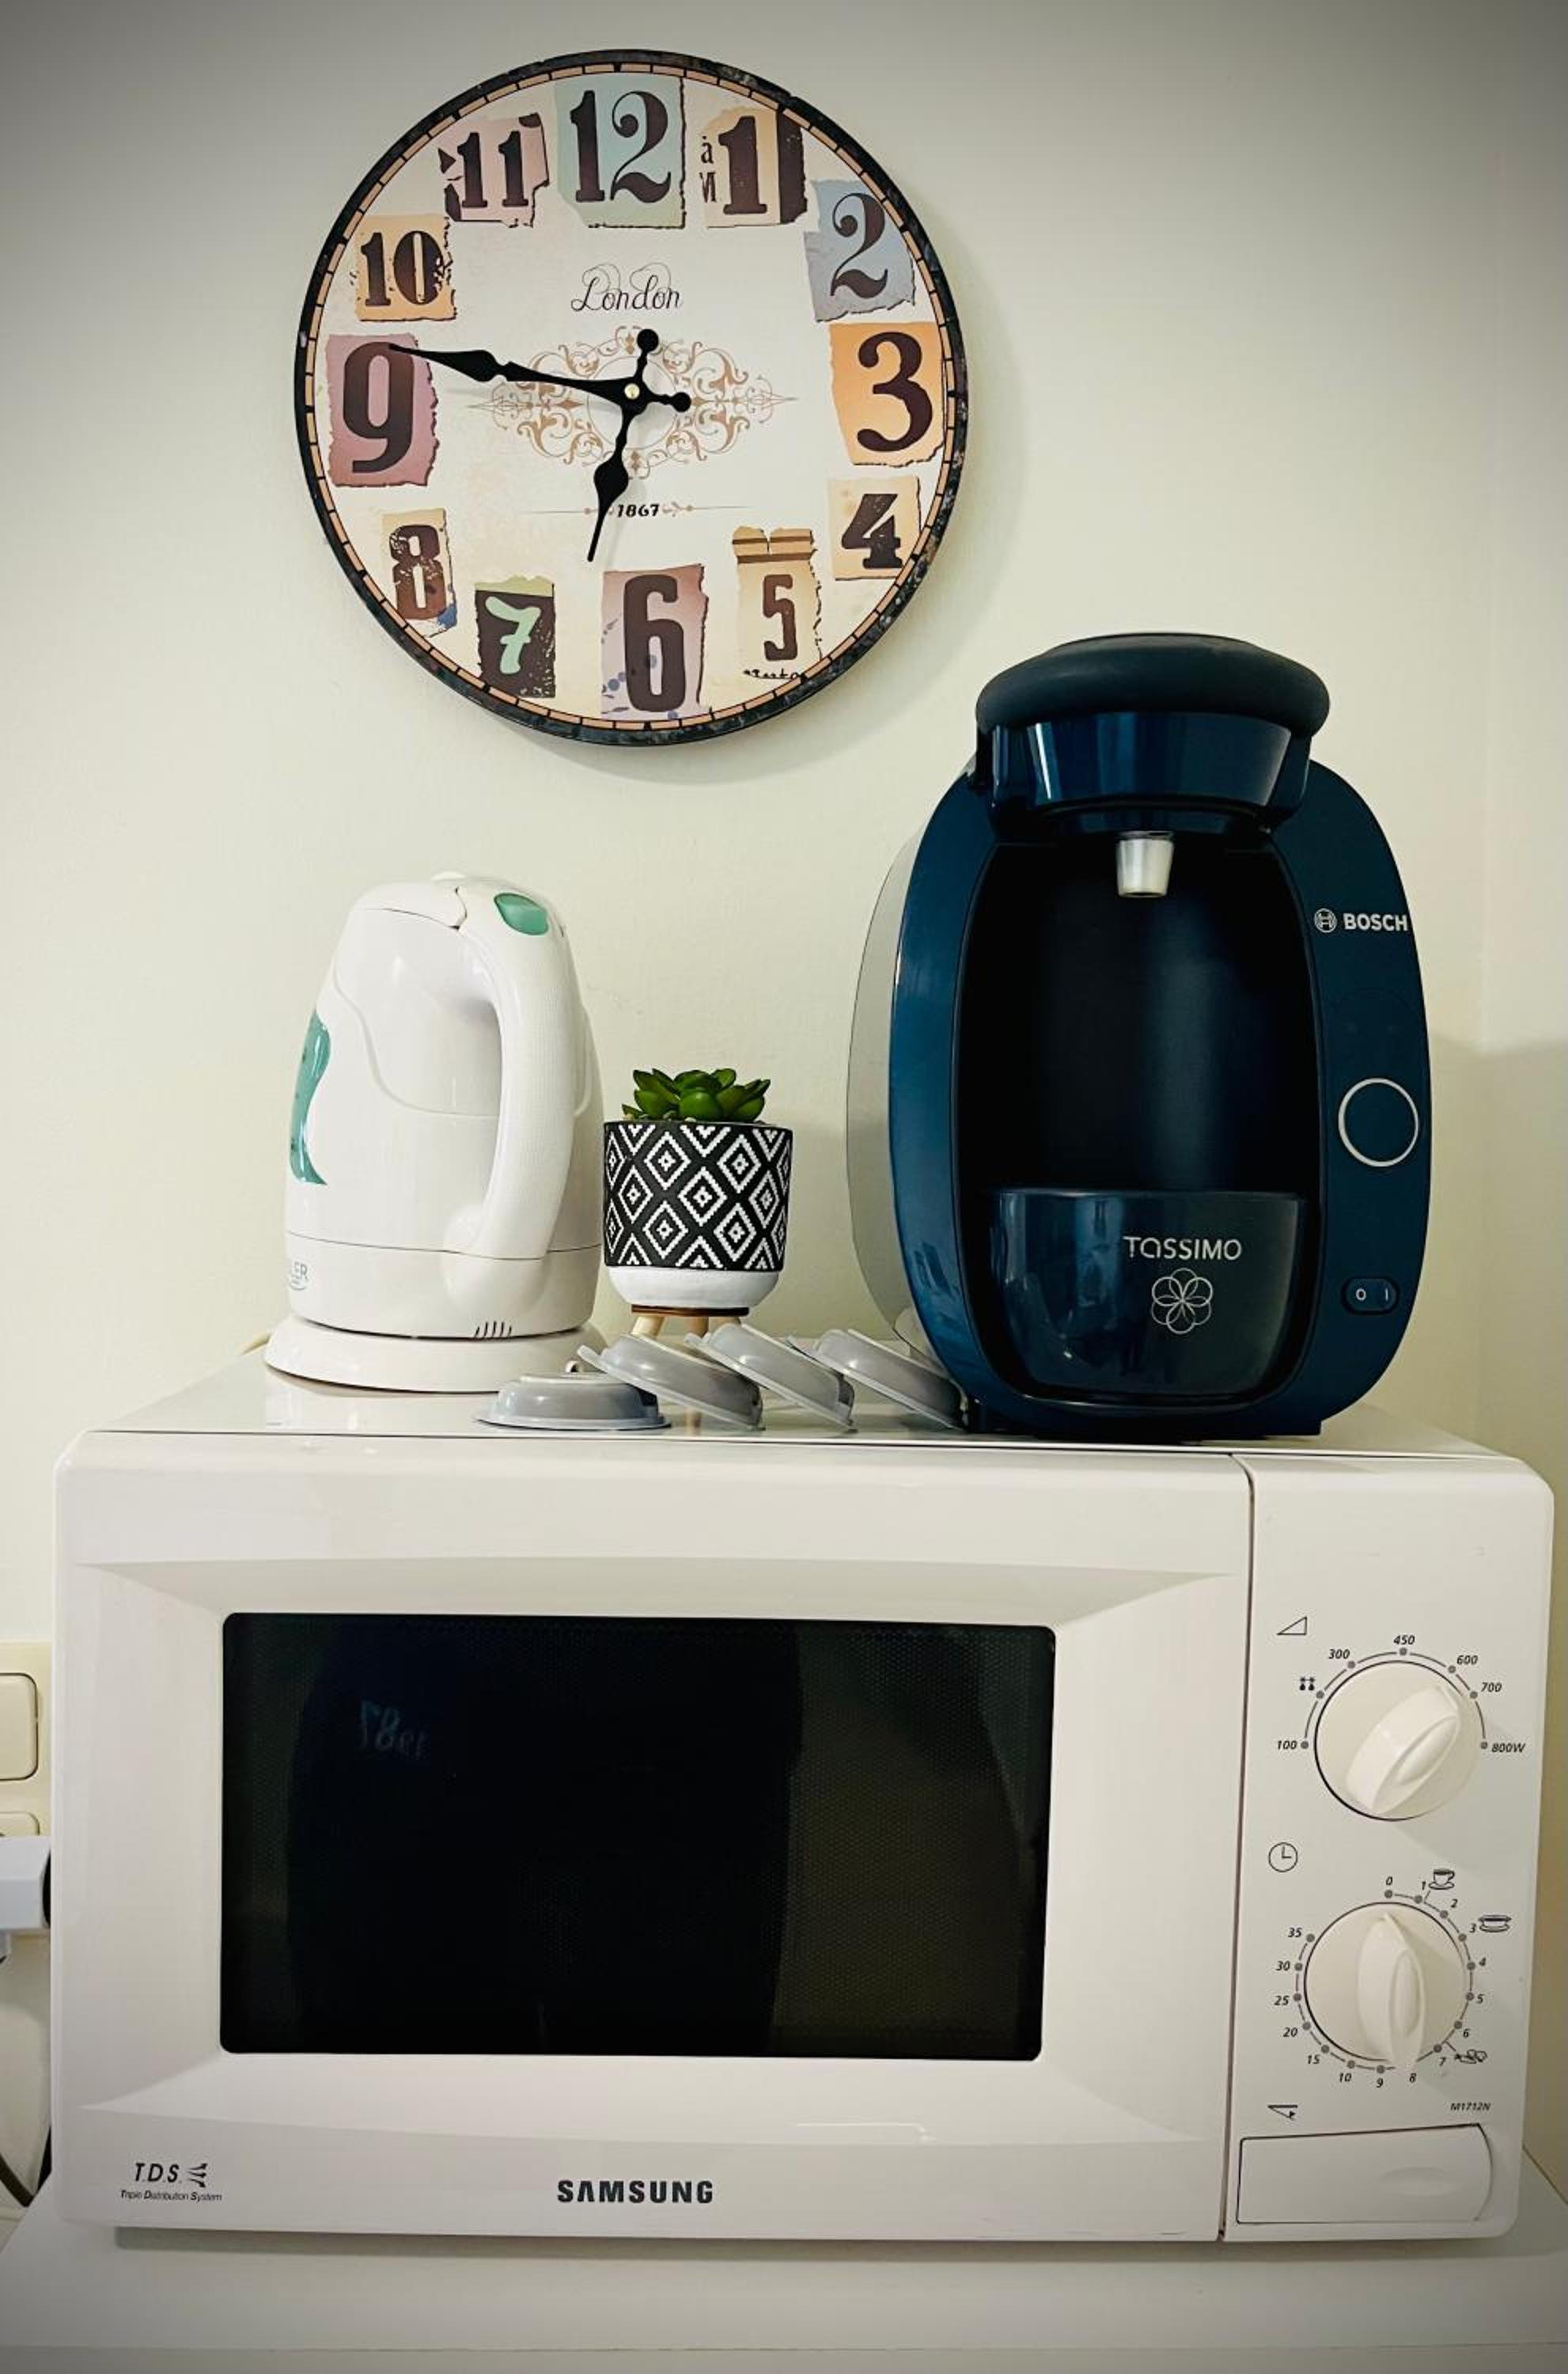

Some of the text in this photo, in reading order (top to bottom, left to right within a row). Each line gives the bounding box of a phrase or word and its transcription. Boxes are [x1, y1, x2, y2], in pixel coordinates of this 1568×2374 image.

[570, 89, 672, 203] 12
[456, 131, 530, 209] 11
[718, 116, 767, 214] 1
[830, 192, 888, 299] 2
[360, 229, 445, 307] 10
[570, 262, 681, 312] London
[857, 331, 933, 453] 3
[343, 341, 415, 474] 9
[617, 503, 660, 518] 1867
[840, 493, 903, 570] 4
[388, 524, 448, 620] 8
[762, 573, 798, 662] 5
[484, 595, 542, 675] 7
[623, 574, 687, 712] 6
[1343, 912, 1409, 931] BOSCH
[1122, 1235, 1242, 1261] TASSIMO
[1393, 1634, 1416, 1646] 450
[1328, 1648, 1351, 1660] 300
[1456, 1654, 1479, 1666] 600
[1480, 1681, 1503, 1693] 700
[1276, 1739, 1298, 1751] 100
[1490, 1742, 1527, 1754] 800W
[1384, 1875, 1394, 1887] 0
[1421, 1879, 1427, 1891] 1
[1450, 1898, 1459, 1909] 2
[1286, 1927, 1303, 1938] 35
[1469, 1922, 1477, 1933] 3
[1275, 1960, 1291, 1971] 30
[1479, 1956, 1487, 1967] 4
[1274, 1995, 1290, 2006] 25
[1477, 1993, 1485, 2004] 5
[1282, 2027, 1299, 2038] 20
[1463, 2027, 1470, 2038] 6
[1307, 2054, 1320, 2065] 15
[1439, 2056, 1447, 2068] 7
[1339, 2073, 1352, 2084] 10
[1377, 2077, 1384, 2089] 9
[1409, 2072, 1417, 2084] 8
[557, 2179, 714, 2204] SAMSUNG
